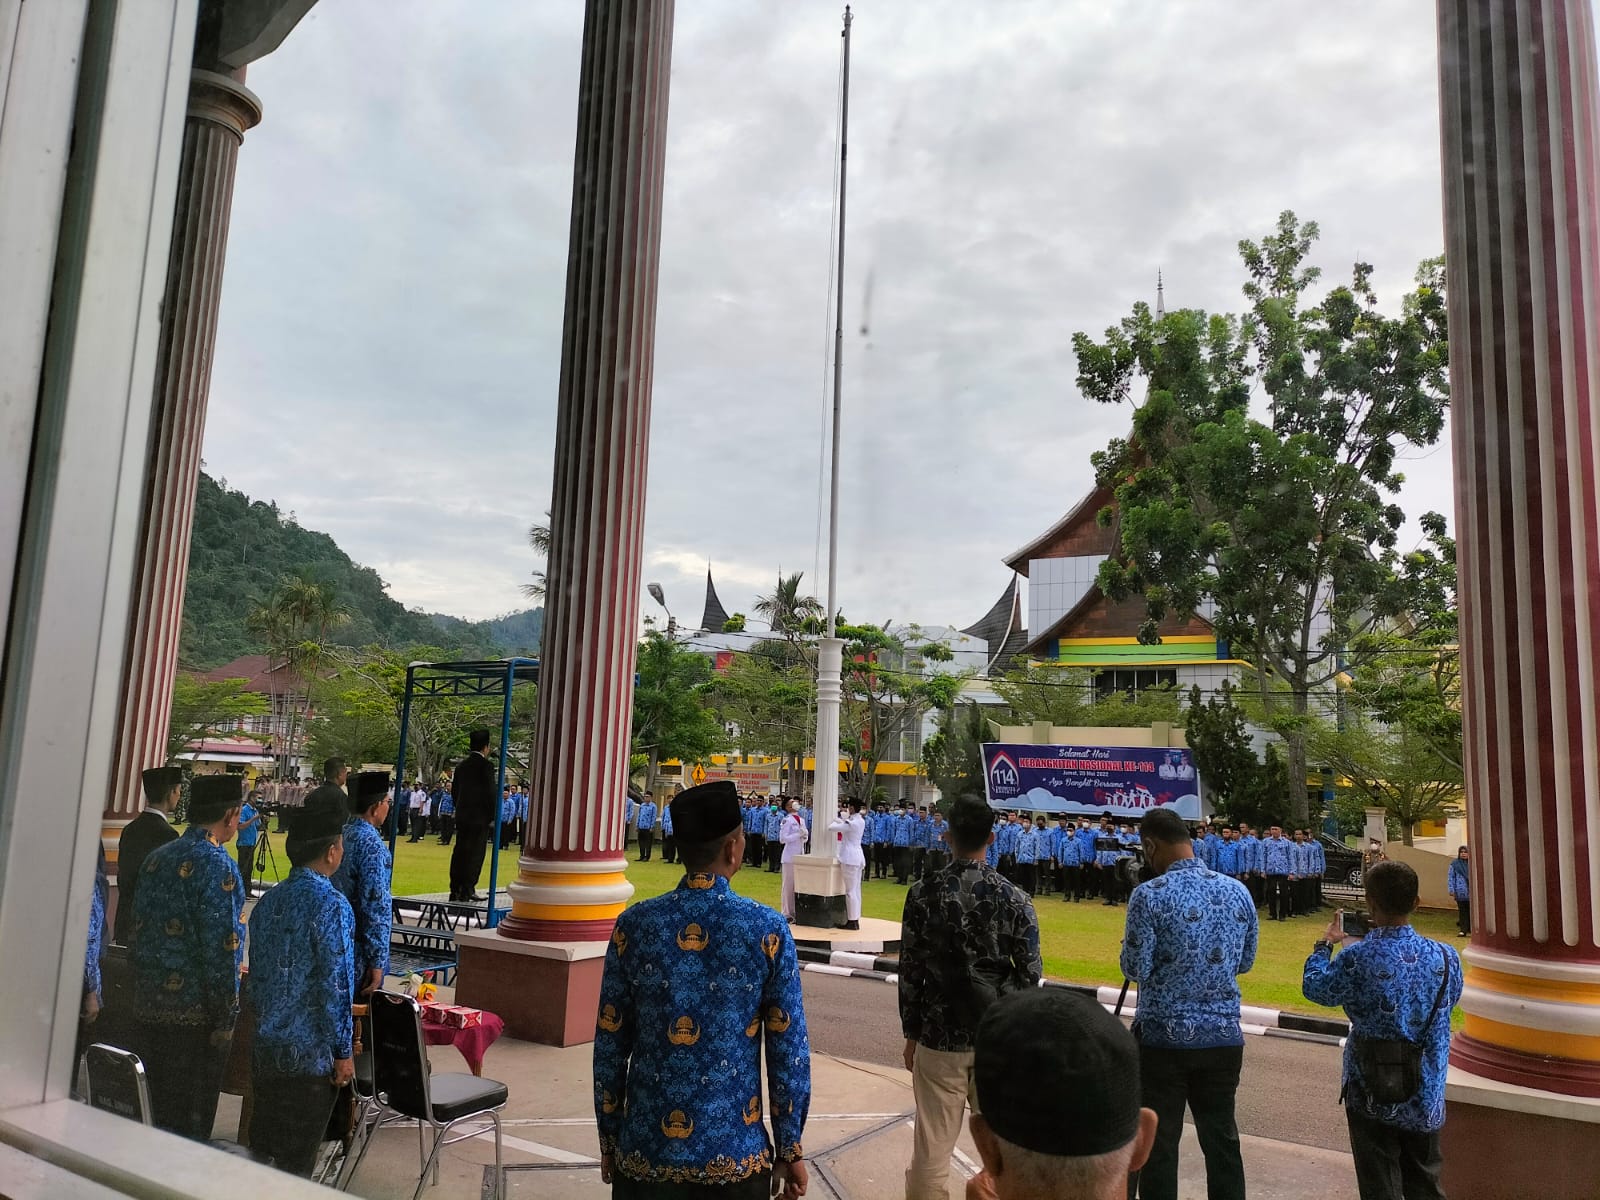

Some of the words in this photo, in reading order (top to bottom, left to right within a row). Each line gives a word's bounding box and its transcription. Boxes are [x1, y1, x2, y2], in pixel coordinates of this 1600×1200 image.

[1058, 748, 1091, 758] Selamat
[1092, 749, 1110, 759] Hari
[1018, 757, 1078, 770] KEBANGKITAN
[1079, 760, 1123, 771] NASIONAL
[1123, 761, 1155, 773] KE-114
[993, 768, 1015, 785] 114
[1048, 777, 1063, 787] Ayo
[1093, 778, 1124, 788] Bersama
